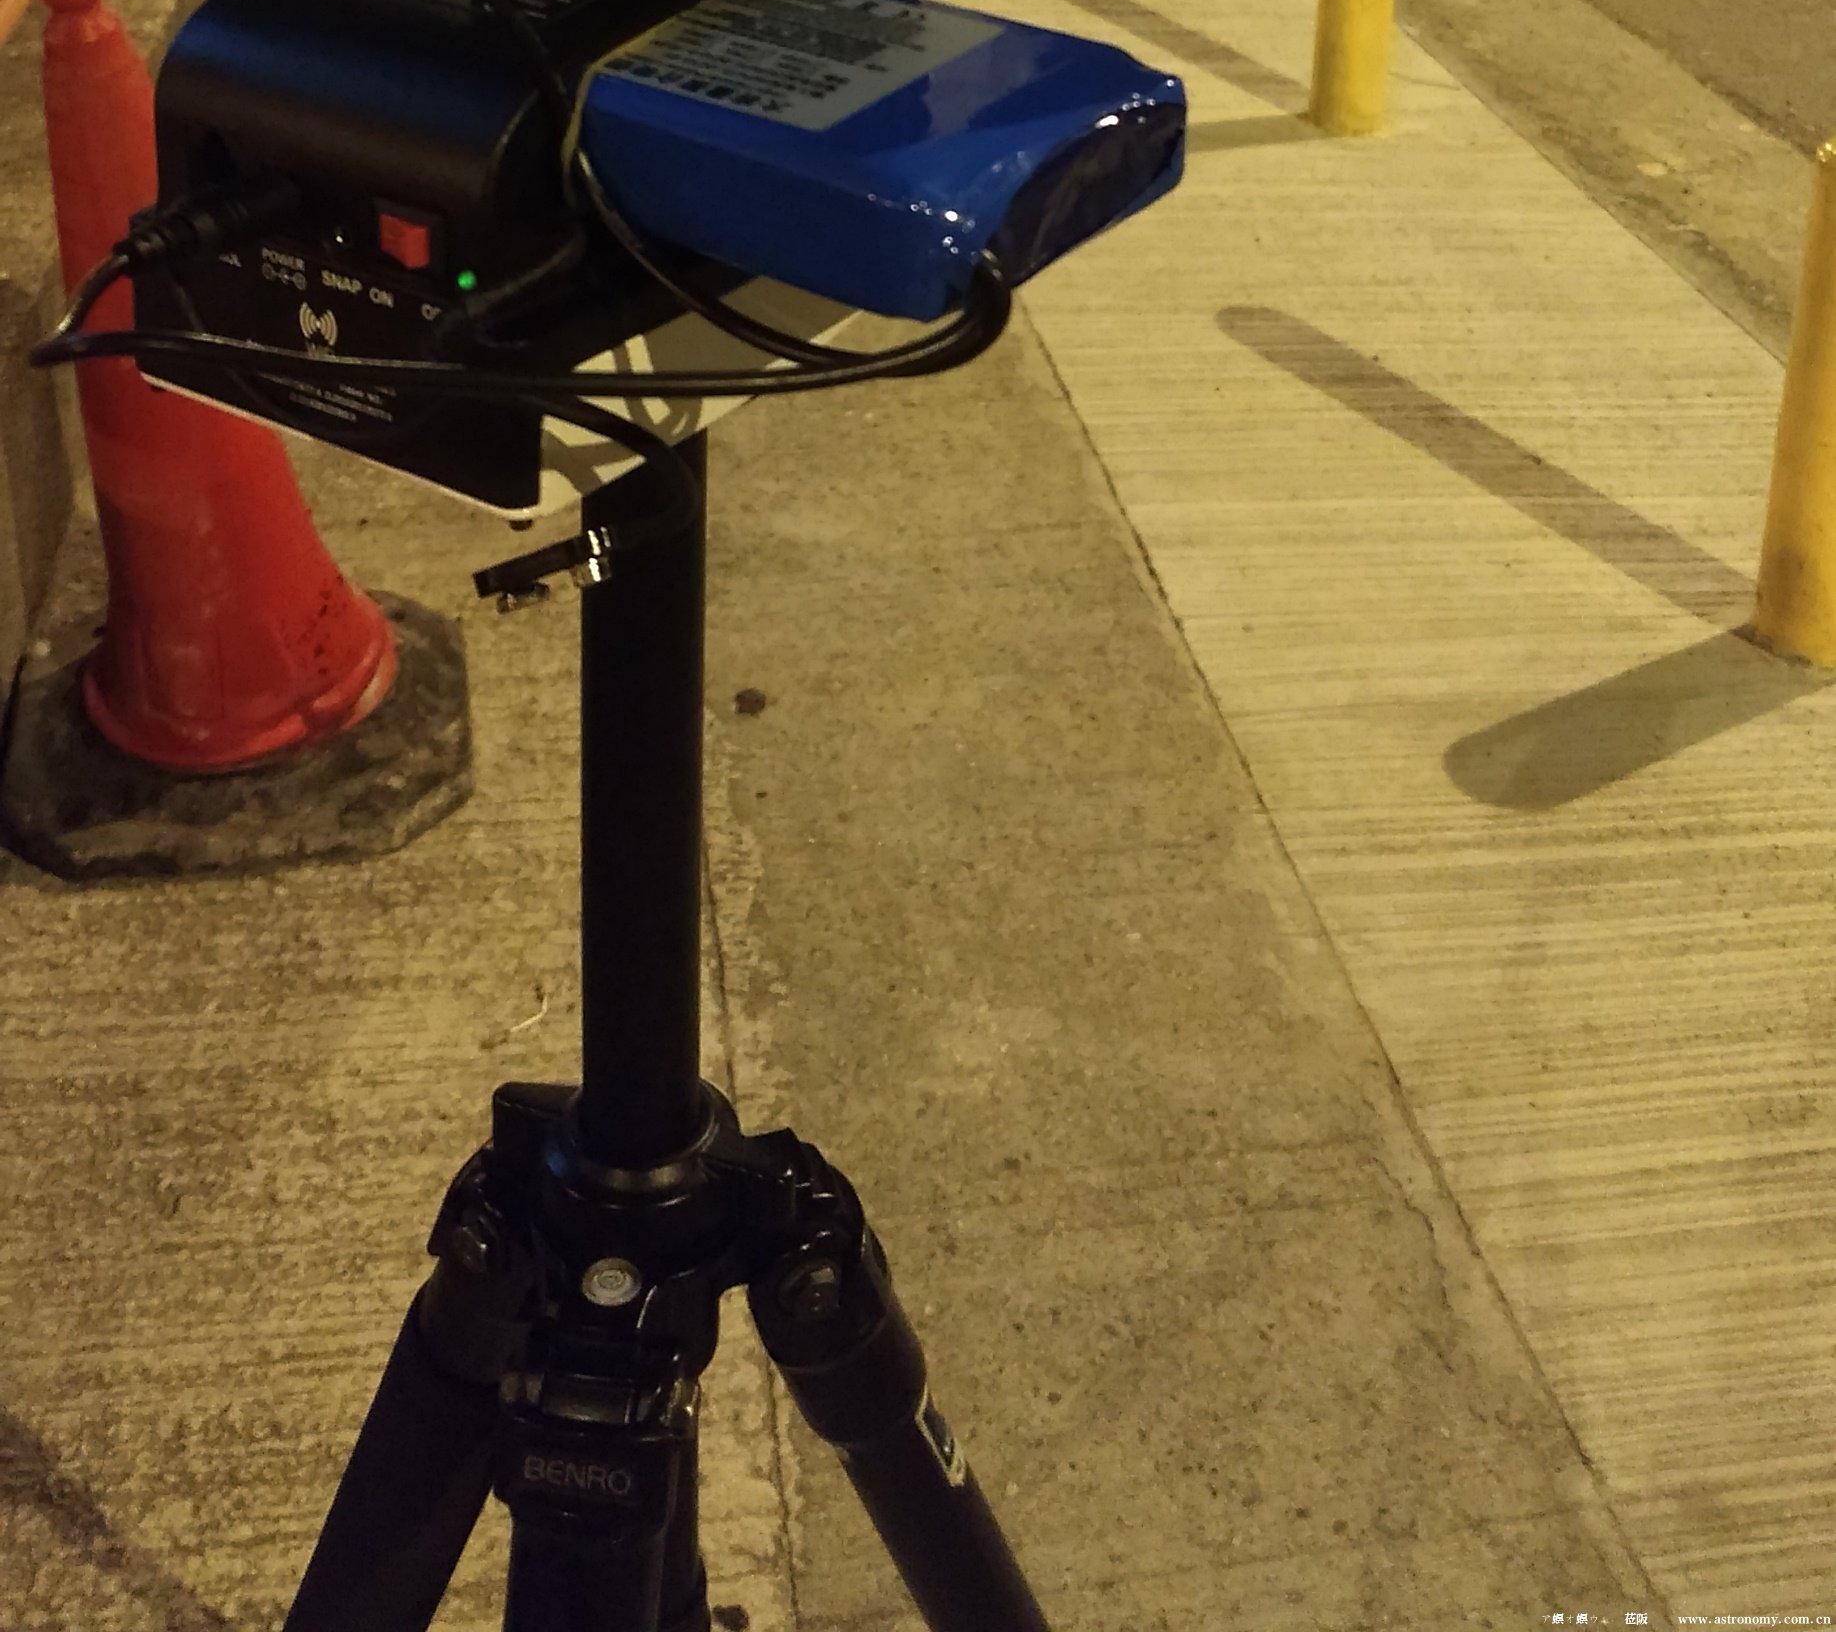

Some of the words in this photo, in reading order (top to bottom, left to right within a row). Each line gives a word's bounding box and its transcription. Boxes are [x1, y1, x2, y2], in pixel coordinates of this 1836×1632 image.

[262, 247, 305, 271] POWER
[321, 270, 363, 294] SNAP
[369, 287, 395, 308] ON
[524, 1455, 631, 1494] BENRO
